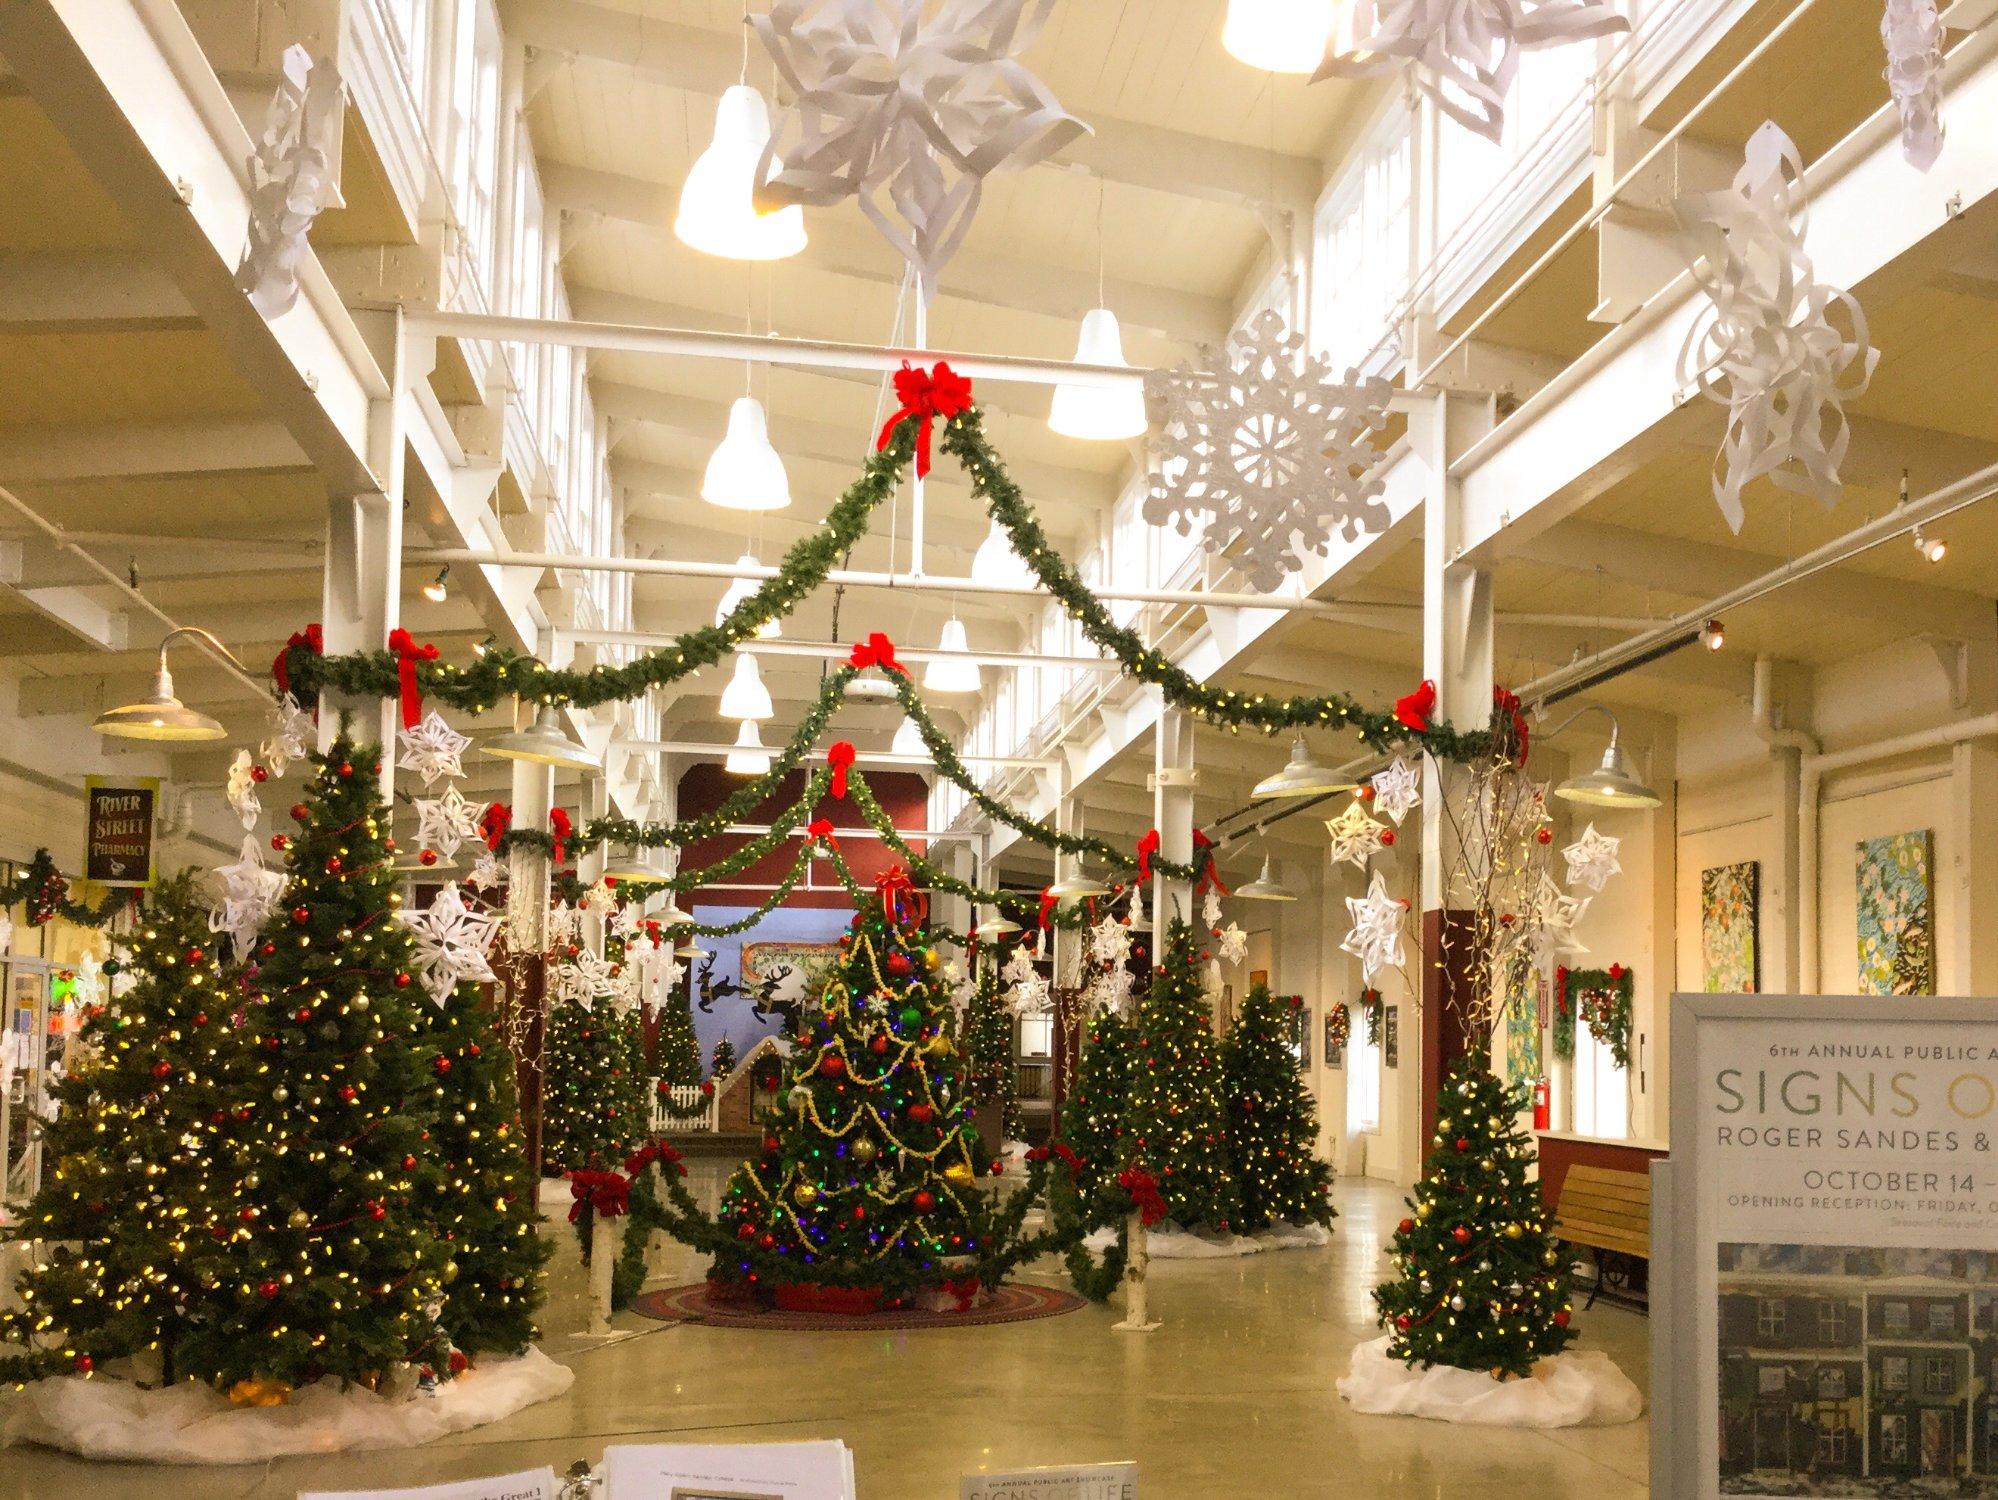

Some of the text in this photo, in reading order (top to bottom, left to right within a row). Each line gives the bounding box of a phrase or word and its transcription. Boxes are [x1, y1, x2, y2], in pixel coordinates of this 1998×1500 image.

[97, 796, 141, 817] RIVER
[95, 819, 145, 839] STREET
[92, 842, 145, 857] PHARMACY
[1808, 1044, 1895, 1059] ANNUAL
[1904, 1046, 1978, 1060] PUBLIC
[1716, 1069, 1919, 1118] SIGNS
[1718, 1127, 1991, 1151] ROGER SANDES &
[1803, 1170, 1938, 1192] OCTOBER
[1950, 1174, 1975, 1193] 14
[1728, 1195, 1804, 1208] OPENING
